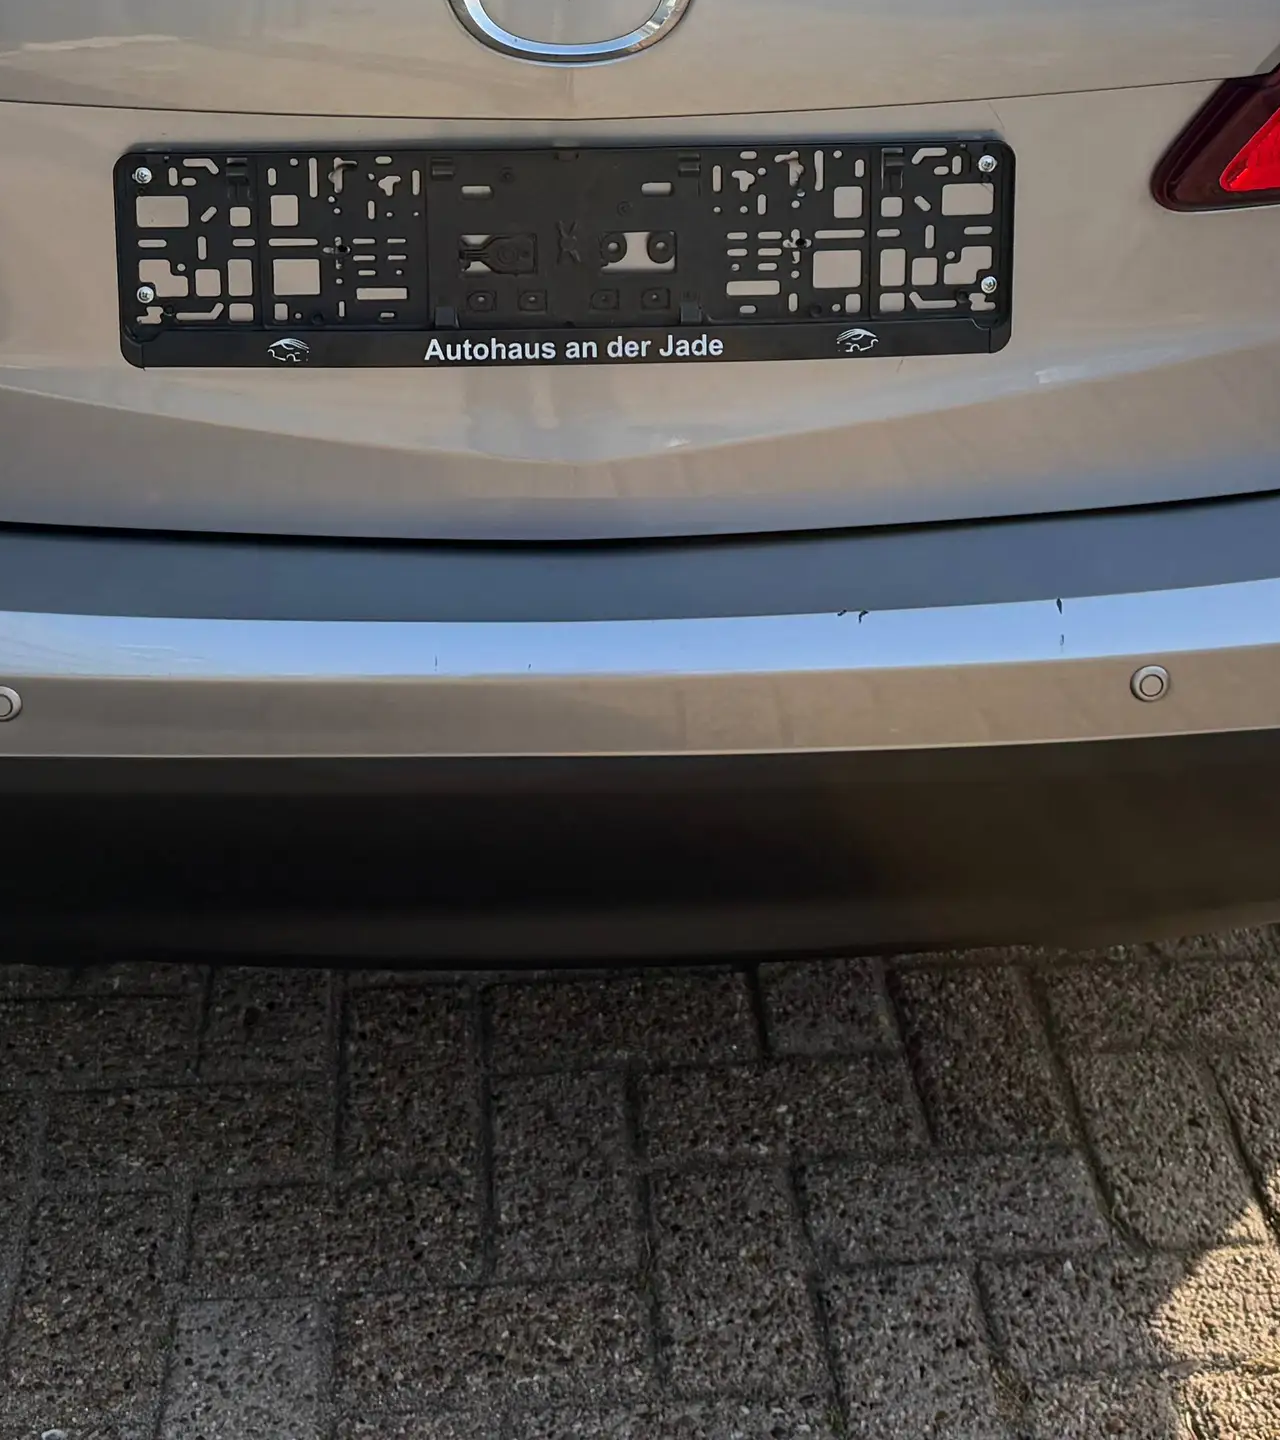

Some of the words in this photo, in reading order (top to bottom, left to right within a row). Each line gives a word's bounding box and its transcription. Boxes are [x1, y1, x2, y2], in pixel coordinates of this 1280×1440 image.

[423, 337, 557, 361] Autohaus
[565, 339, 598, 359] an
[607, 335, 652, 358] der
[659, 334, 724, 357] Jade
